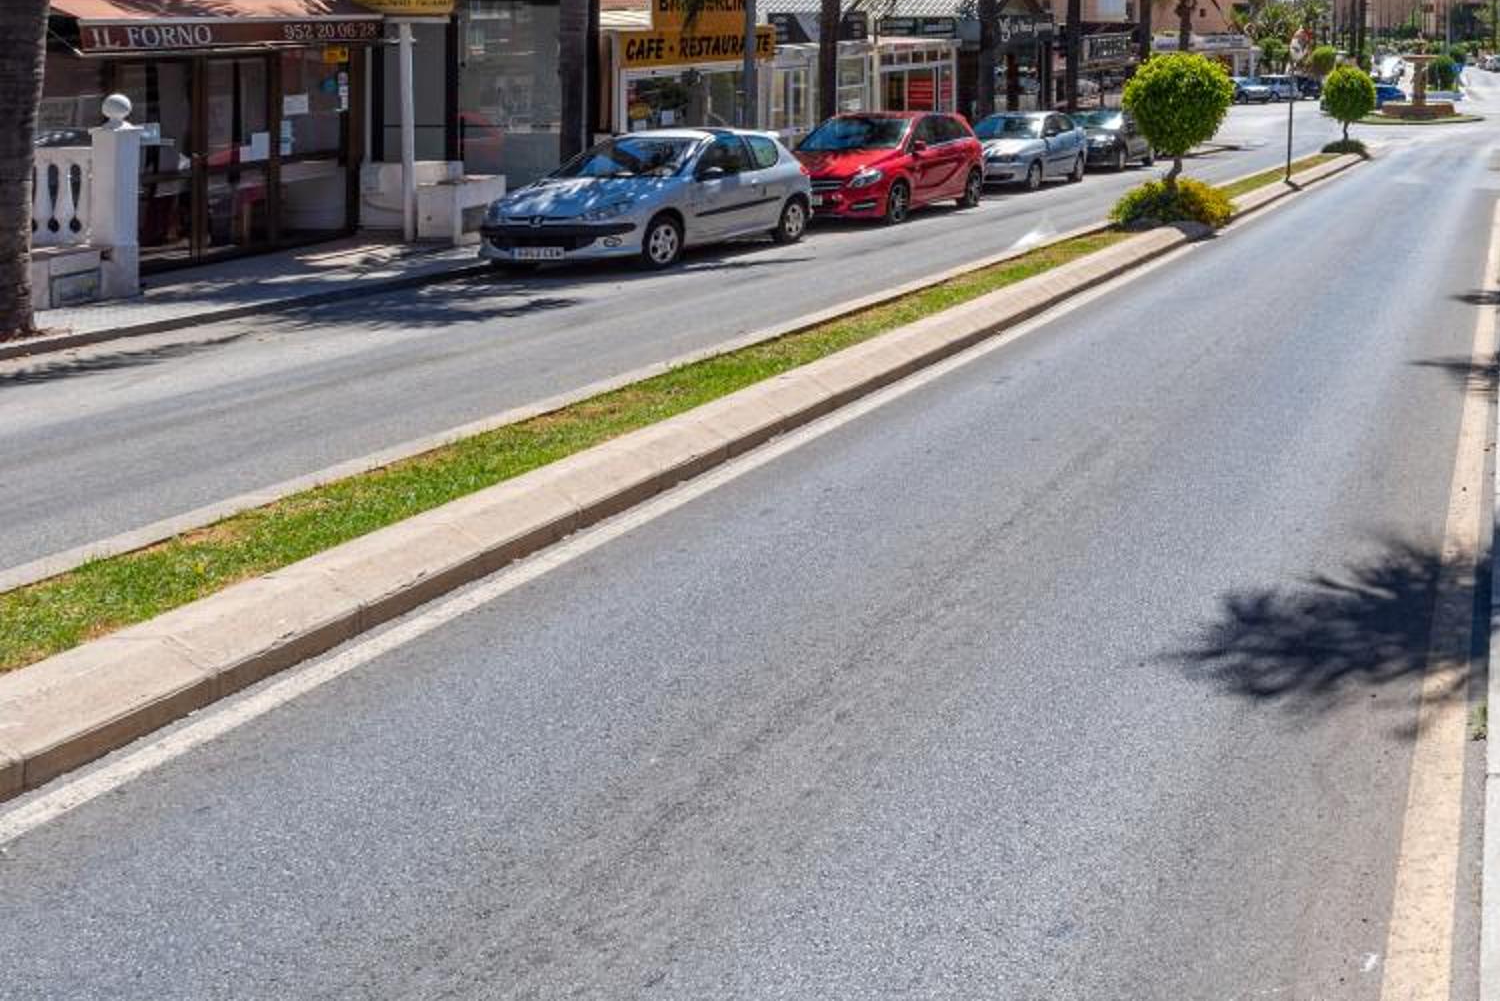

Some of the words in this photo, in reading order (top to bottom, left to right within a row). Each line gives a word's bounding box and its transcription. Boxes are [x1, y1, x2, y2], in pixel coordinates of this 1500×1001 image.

[92, 27, 120, 48] IL
[127, 24, 212, 48] FORNO
[284, 23, 314, 40] 952
[317, 23, 335, 38] 20
[679, 33, 771, 60] RESTAURATE
